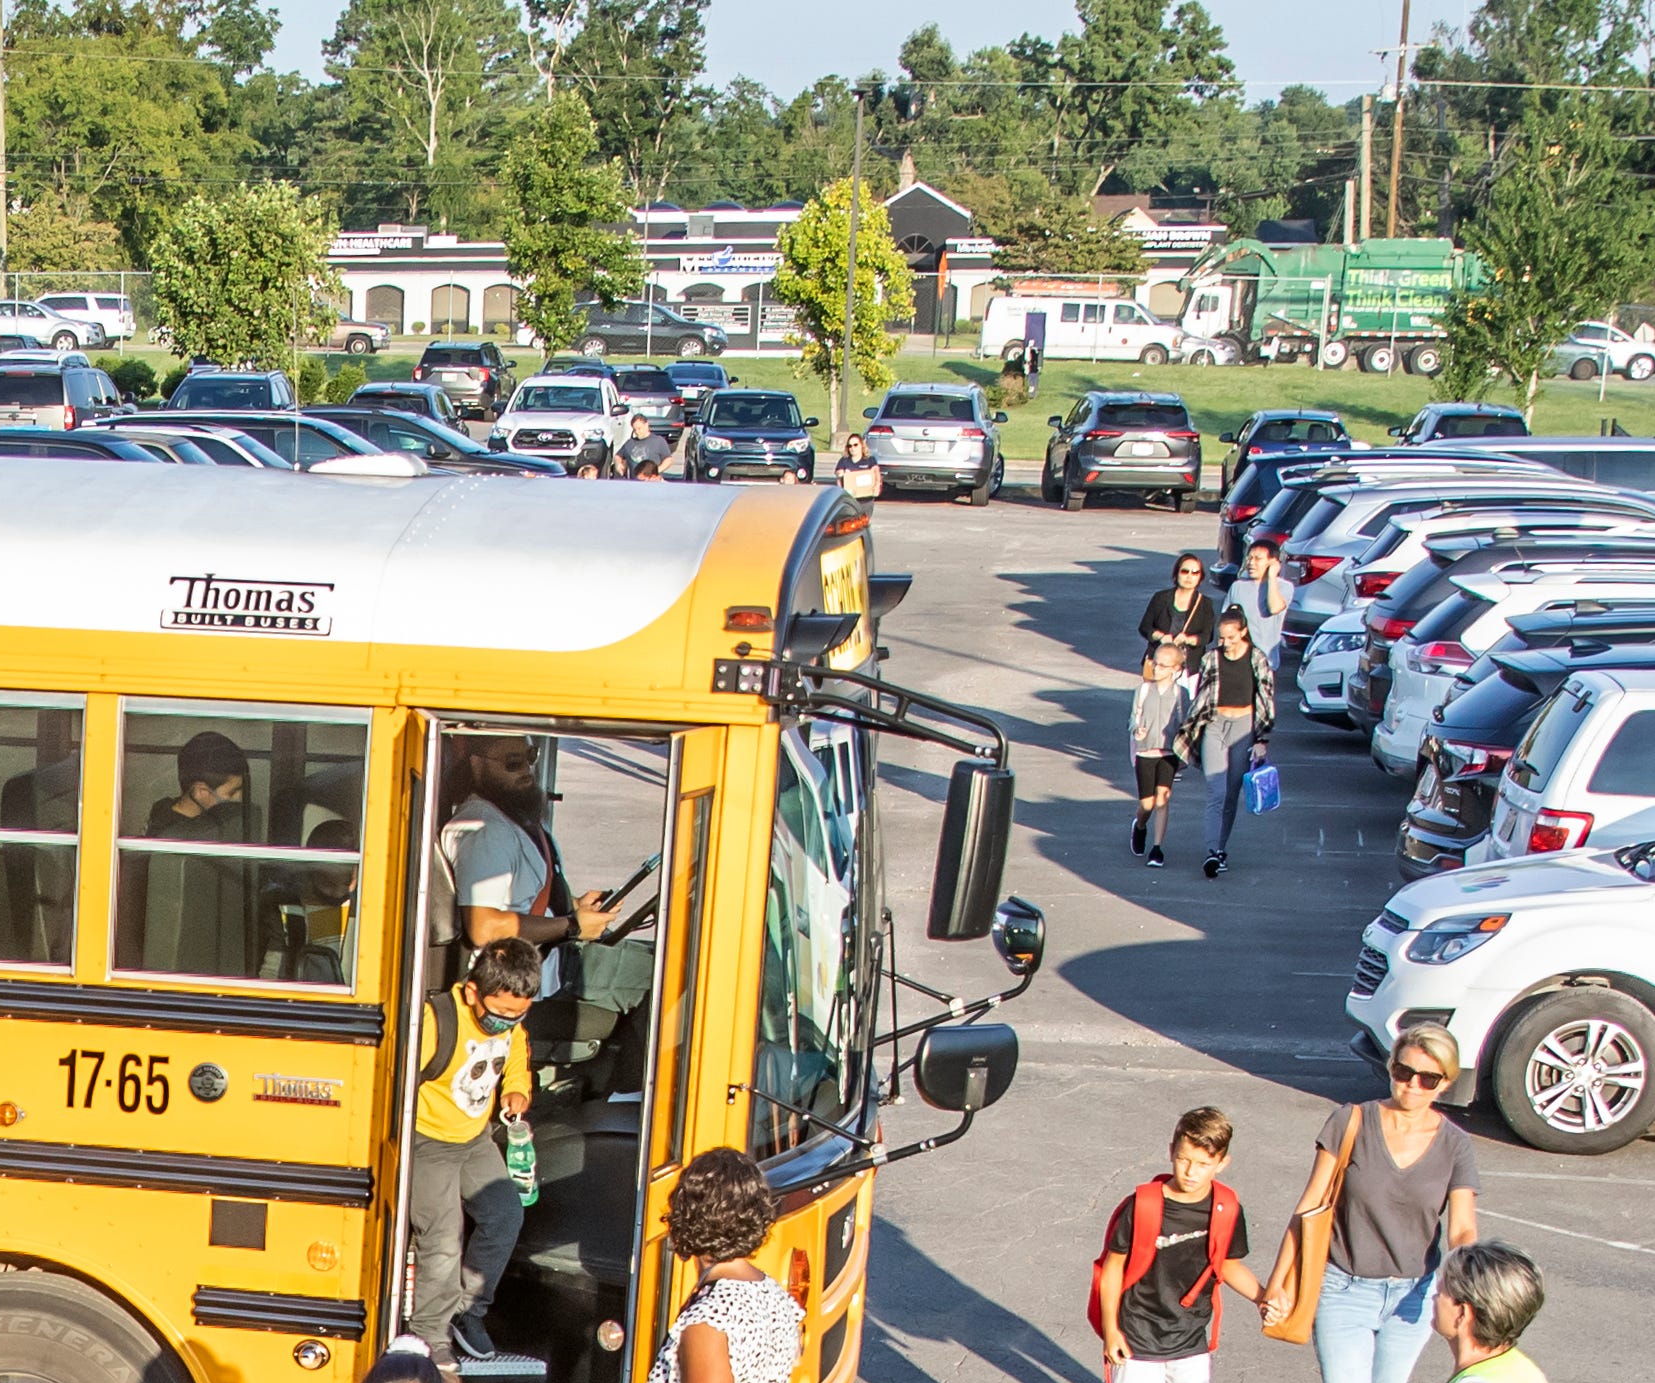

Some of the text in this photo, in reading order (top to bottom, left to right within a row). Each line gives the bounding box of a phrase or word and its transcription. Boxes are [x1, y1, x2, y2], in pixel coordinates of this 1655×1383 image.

[349, 237, 413, 249] HEALTHCARE
[169, 573, 335, 614] Thomas
[176, 613, 316, 631] BUILT BUSES
